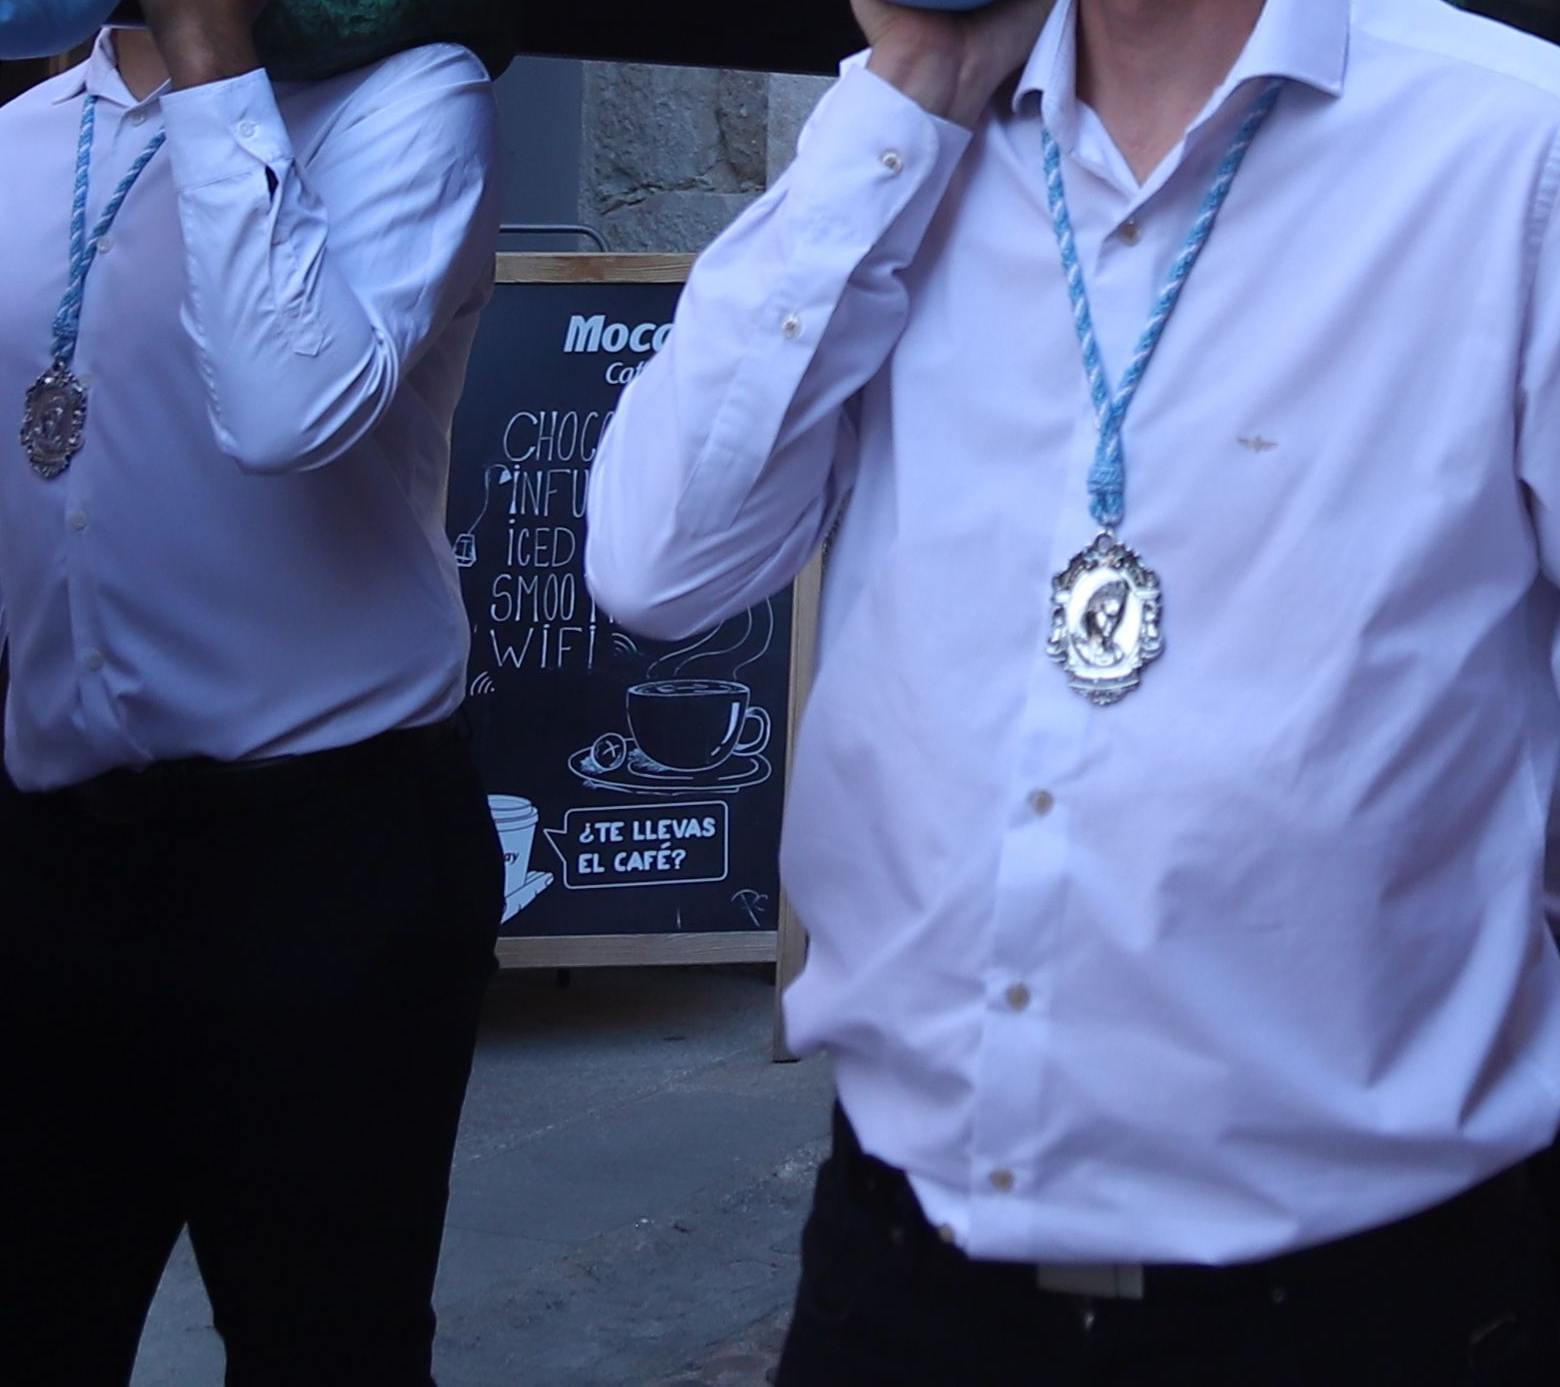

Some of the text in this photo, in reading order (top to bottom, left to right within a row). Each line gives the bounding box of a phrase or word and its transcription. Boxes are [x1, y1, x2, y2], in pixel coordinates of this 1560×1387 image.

[579, 816, 716, 844] ¿TE LLEVAS
[578, 841, 687, 874] EL CAFÉ?
